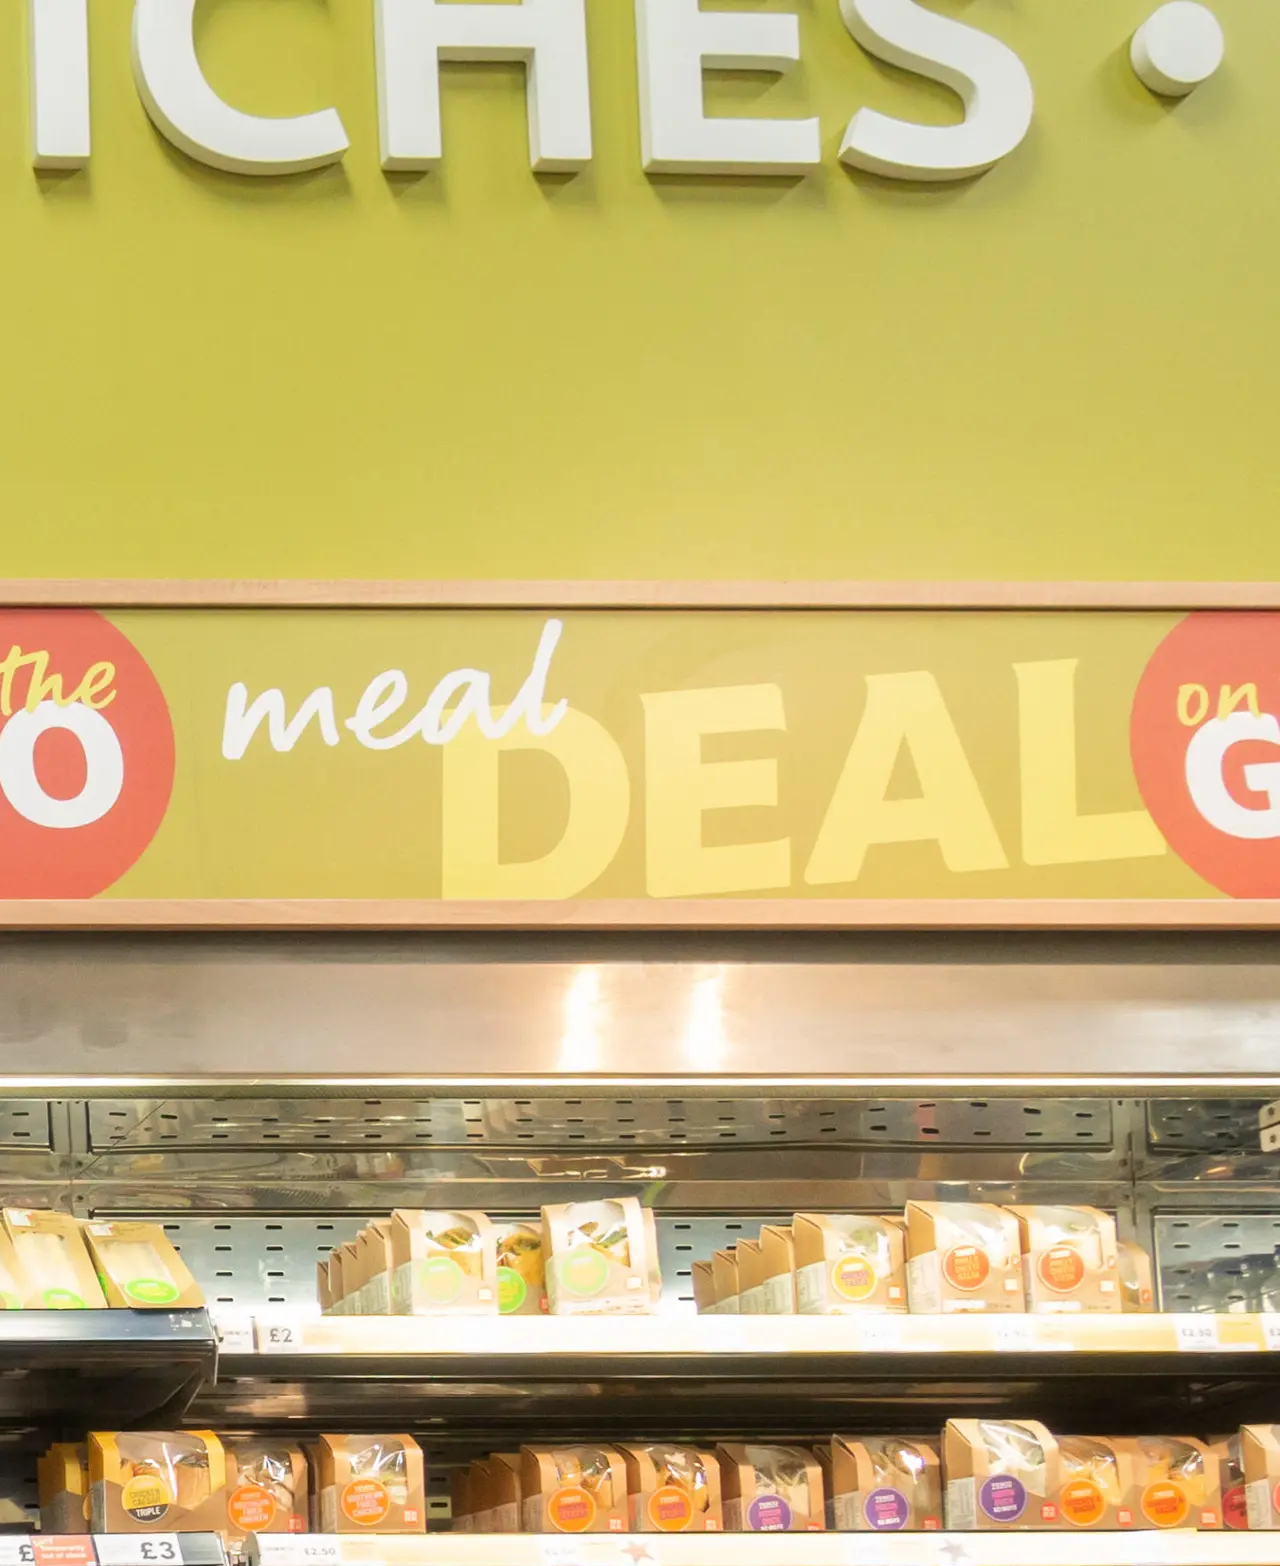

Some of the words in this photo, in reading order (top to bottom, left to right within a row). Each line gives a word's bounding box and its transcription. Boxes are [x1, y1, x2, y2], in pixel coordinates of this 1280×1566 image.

[221, 618, 569, 761] meal
[1176, 684, 1259, 727] on
[442, 657, 1166, 900] DEAL
[269, 1328, 293, 1343] £2
[136, 1506, 161, 1517] TRIPLE
[142, 1542, 176, 1560] £3
